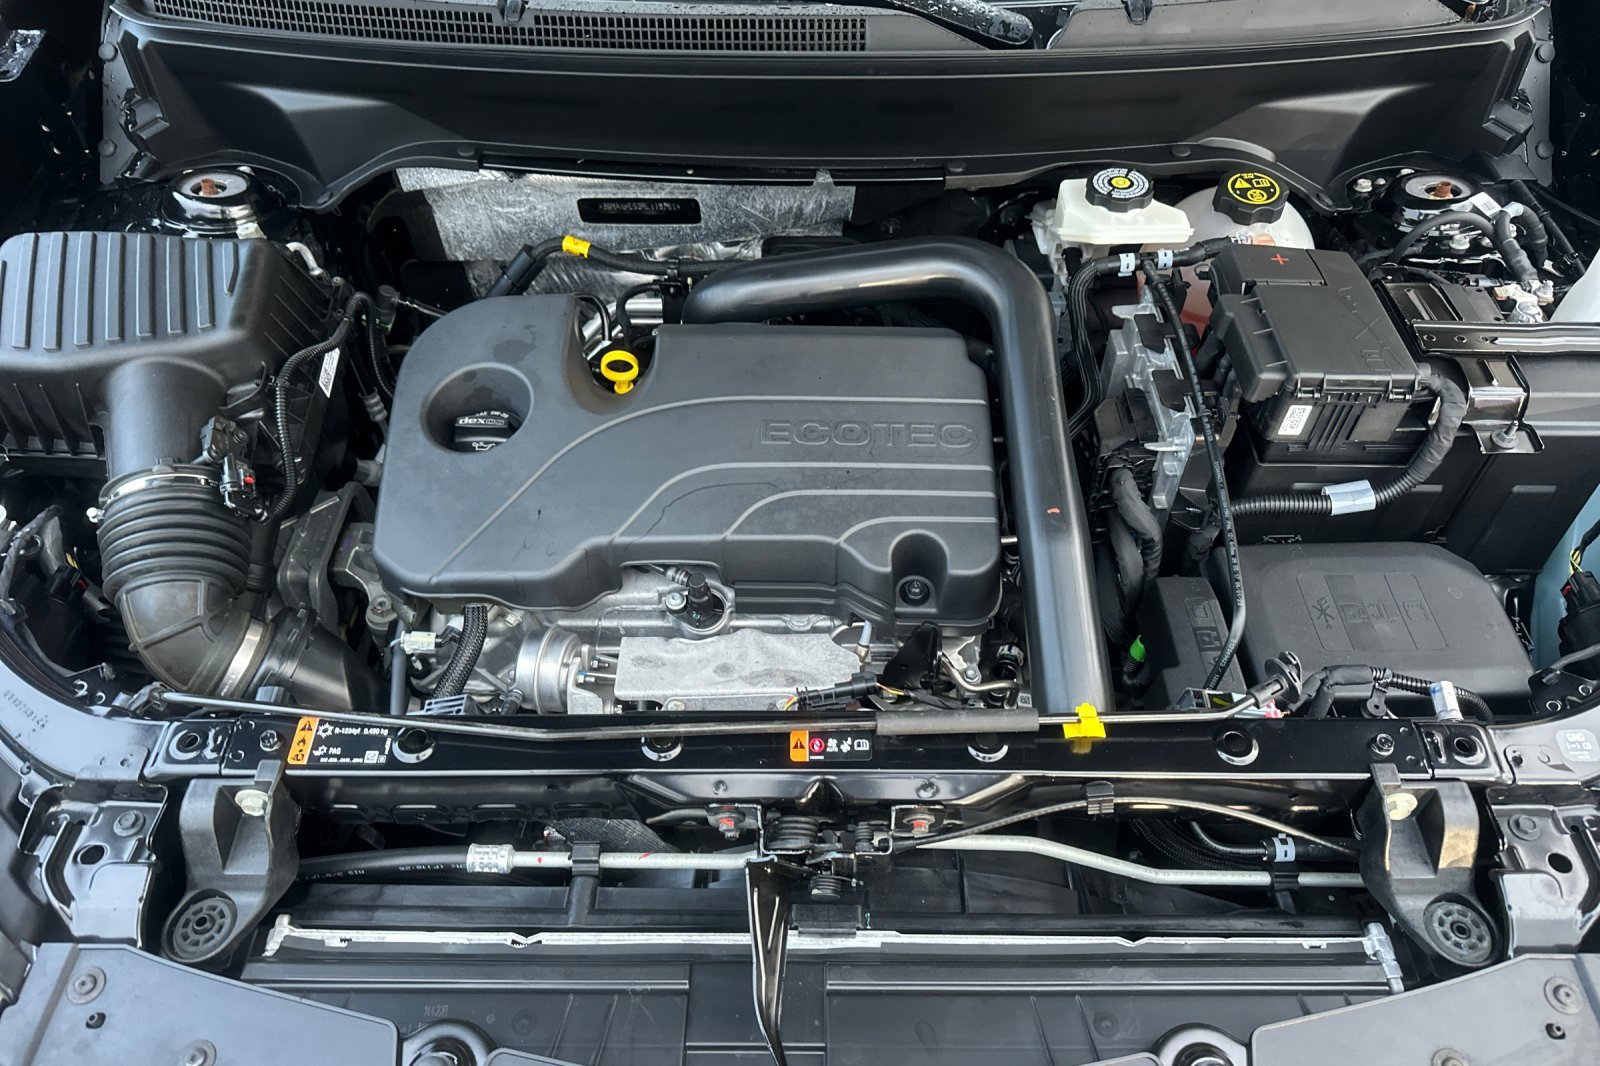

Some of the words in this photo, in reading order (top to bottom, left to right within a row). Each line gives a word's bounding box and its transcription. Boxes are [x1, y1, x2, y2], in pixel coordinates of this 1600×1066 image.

[459, 417, 504, 425] dexos
[761, 420, 976, 448] ECOTEC
[335, 727, 361, 736] R-1234yf
[381, 728, 389, 736] kg
[328, 747, 341, 755] PAG
